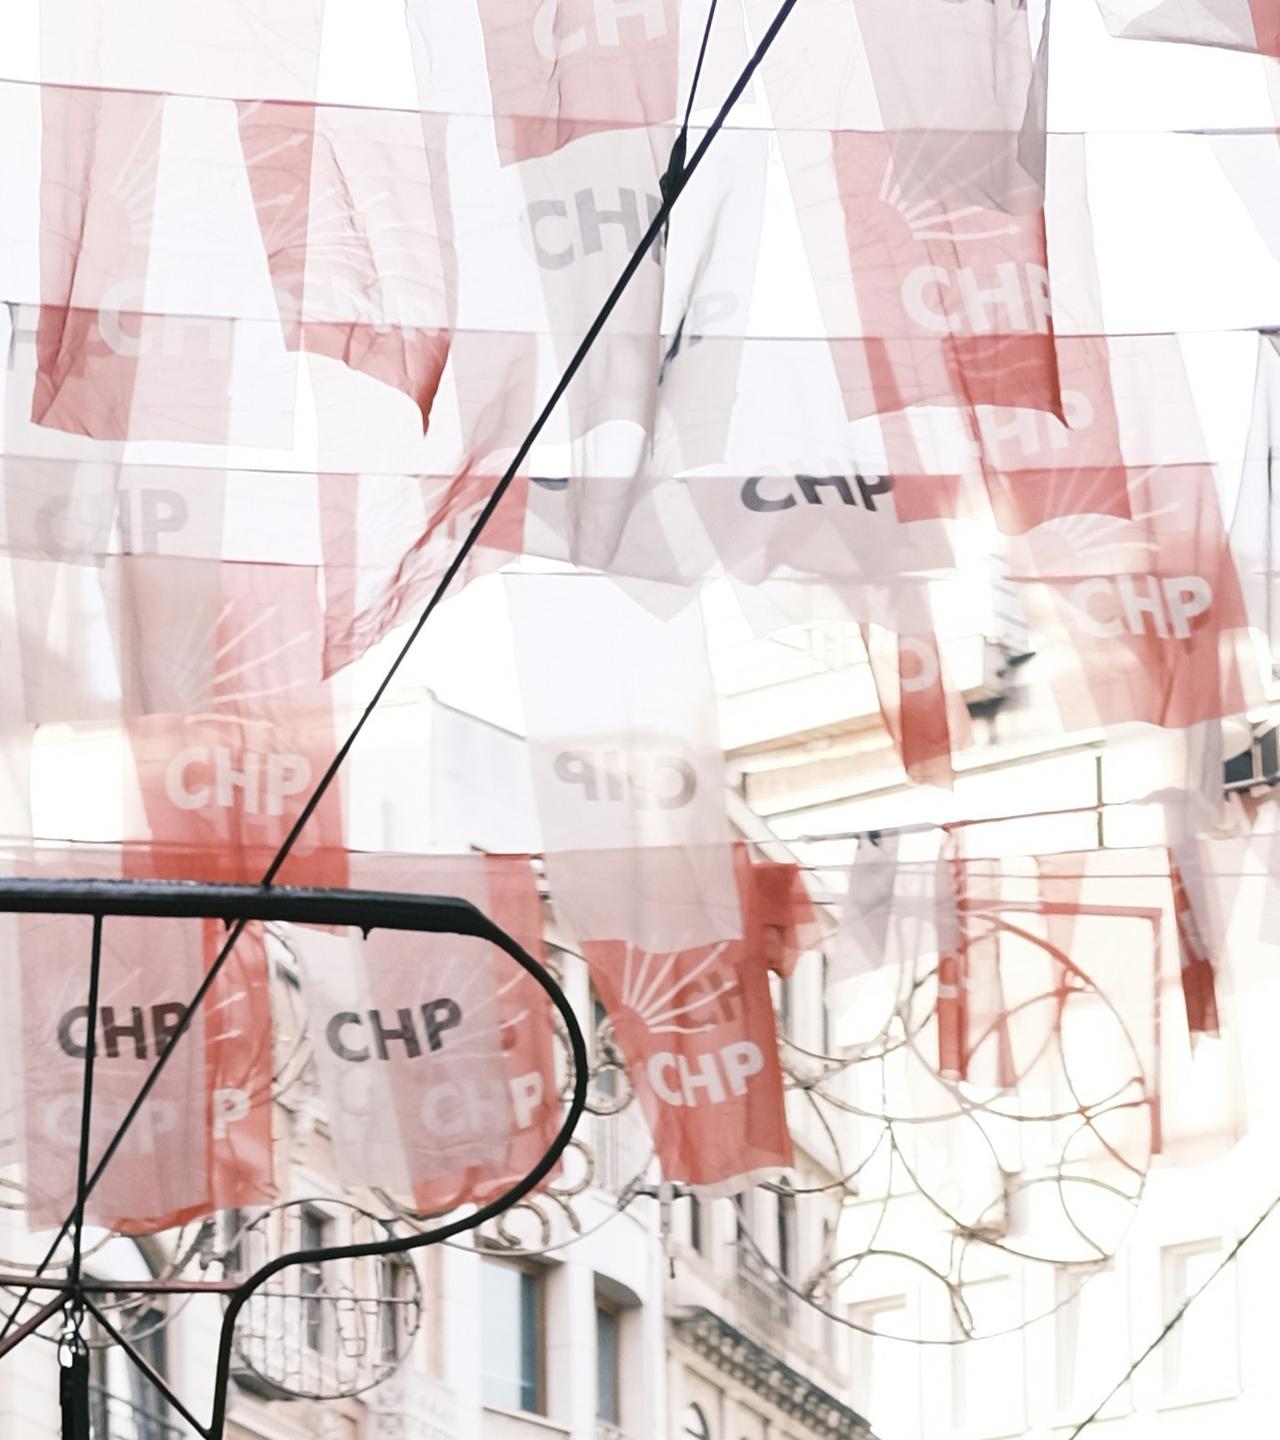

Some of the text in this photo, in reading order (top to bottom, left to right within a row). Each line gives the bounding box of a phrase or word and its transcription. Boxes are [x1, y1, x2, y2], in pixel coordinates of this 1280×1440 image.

[1070, 575, 1211, 640] CHP
[165, 746, 312, 816] CHP
[56, 1000, 192, 1060] CHP
[326, 997, 463, 1062] CHP
[646, 1041, 764, 1106] CHP
